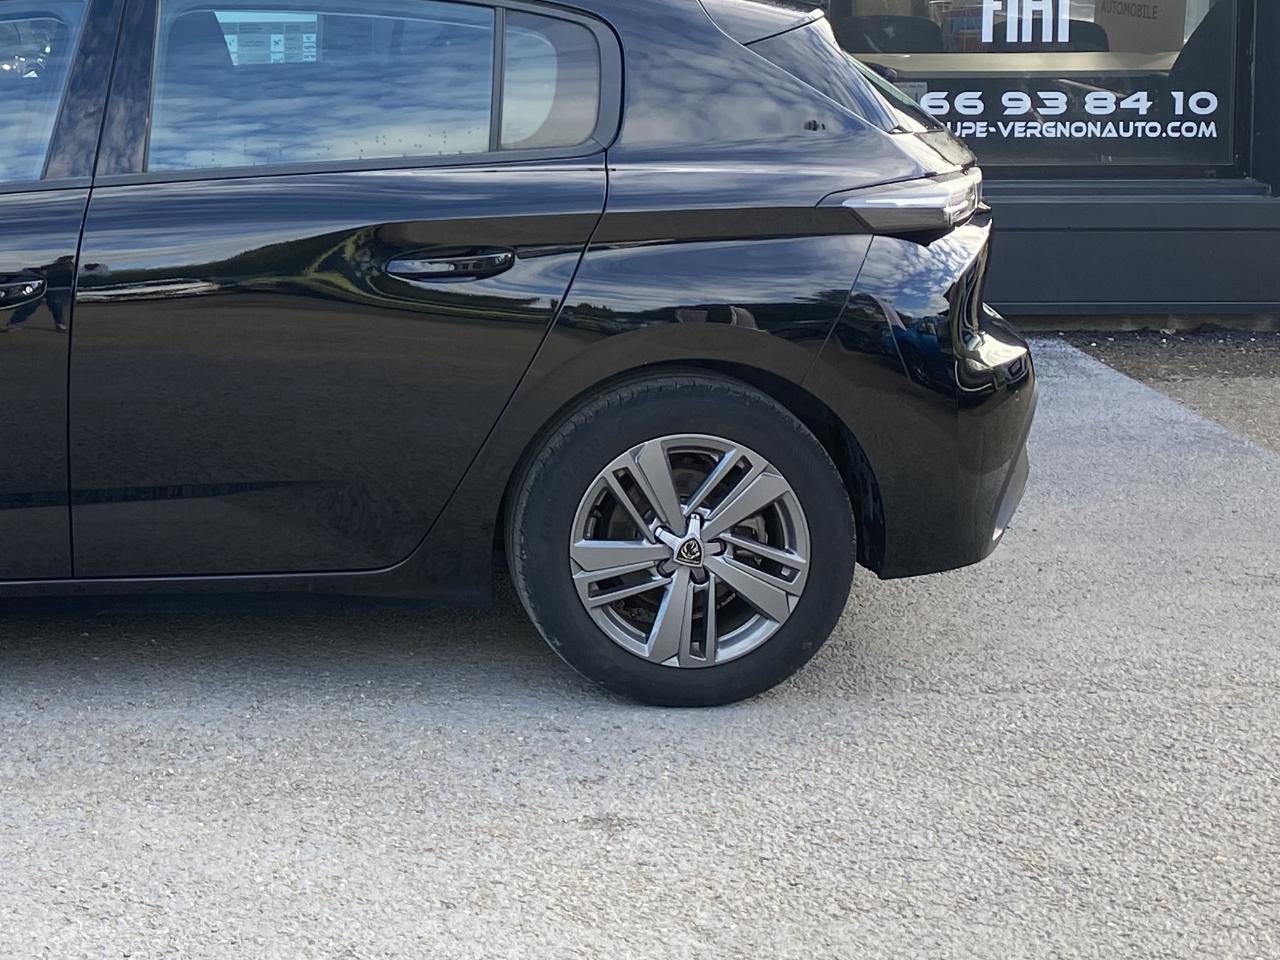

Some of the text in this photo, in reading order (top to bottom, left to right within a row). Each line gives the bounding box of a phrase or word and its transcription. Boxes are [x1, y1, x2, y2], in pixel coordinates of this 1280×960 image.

[921, 91, 1218, 115] 66 93 84 10
[946, 122, 1217, 138] UPE-VERGNONAUTO.COM
